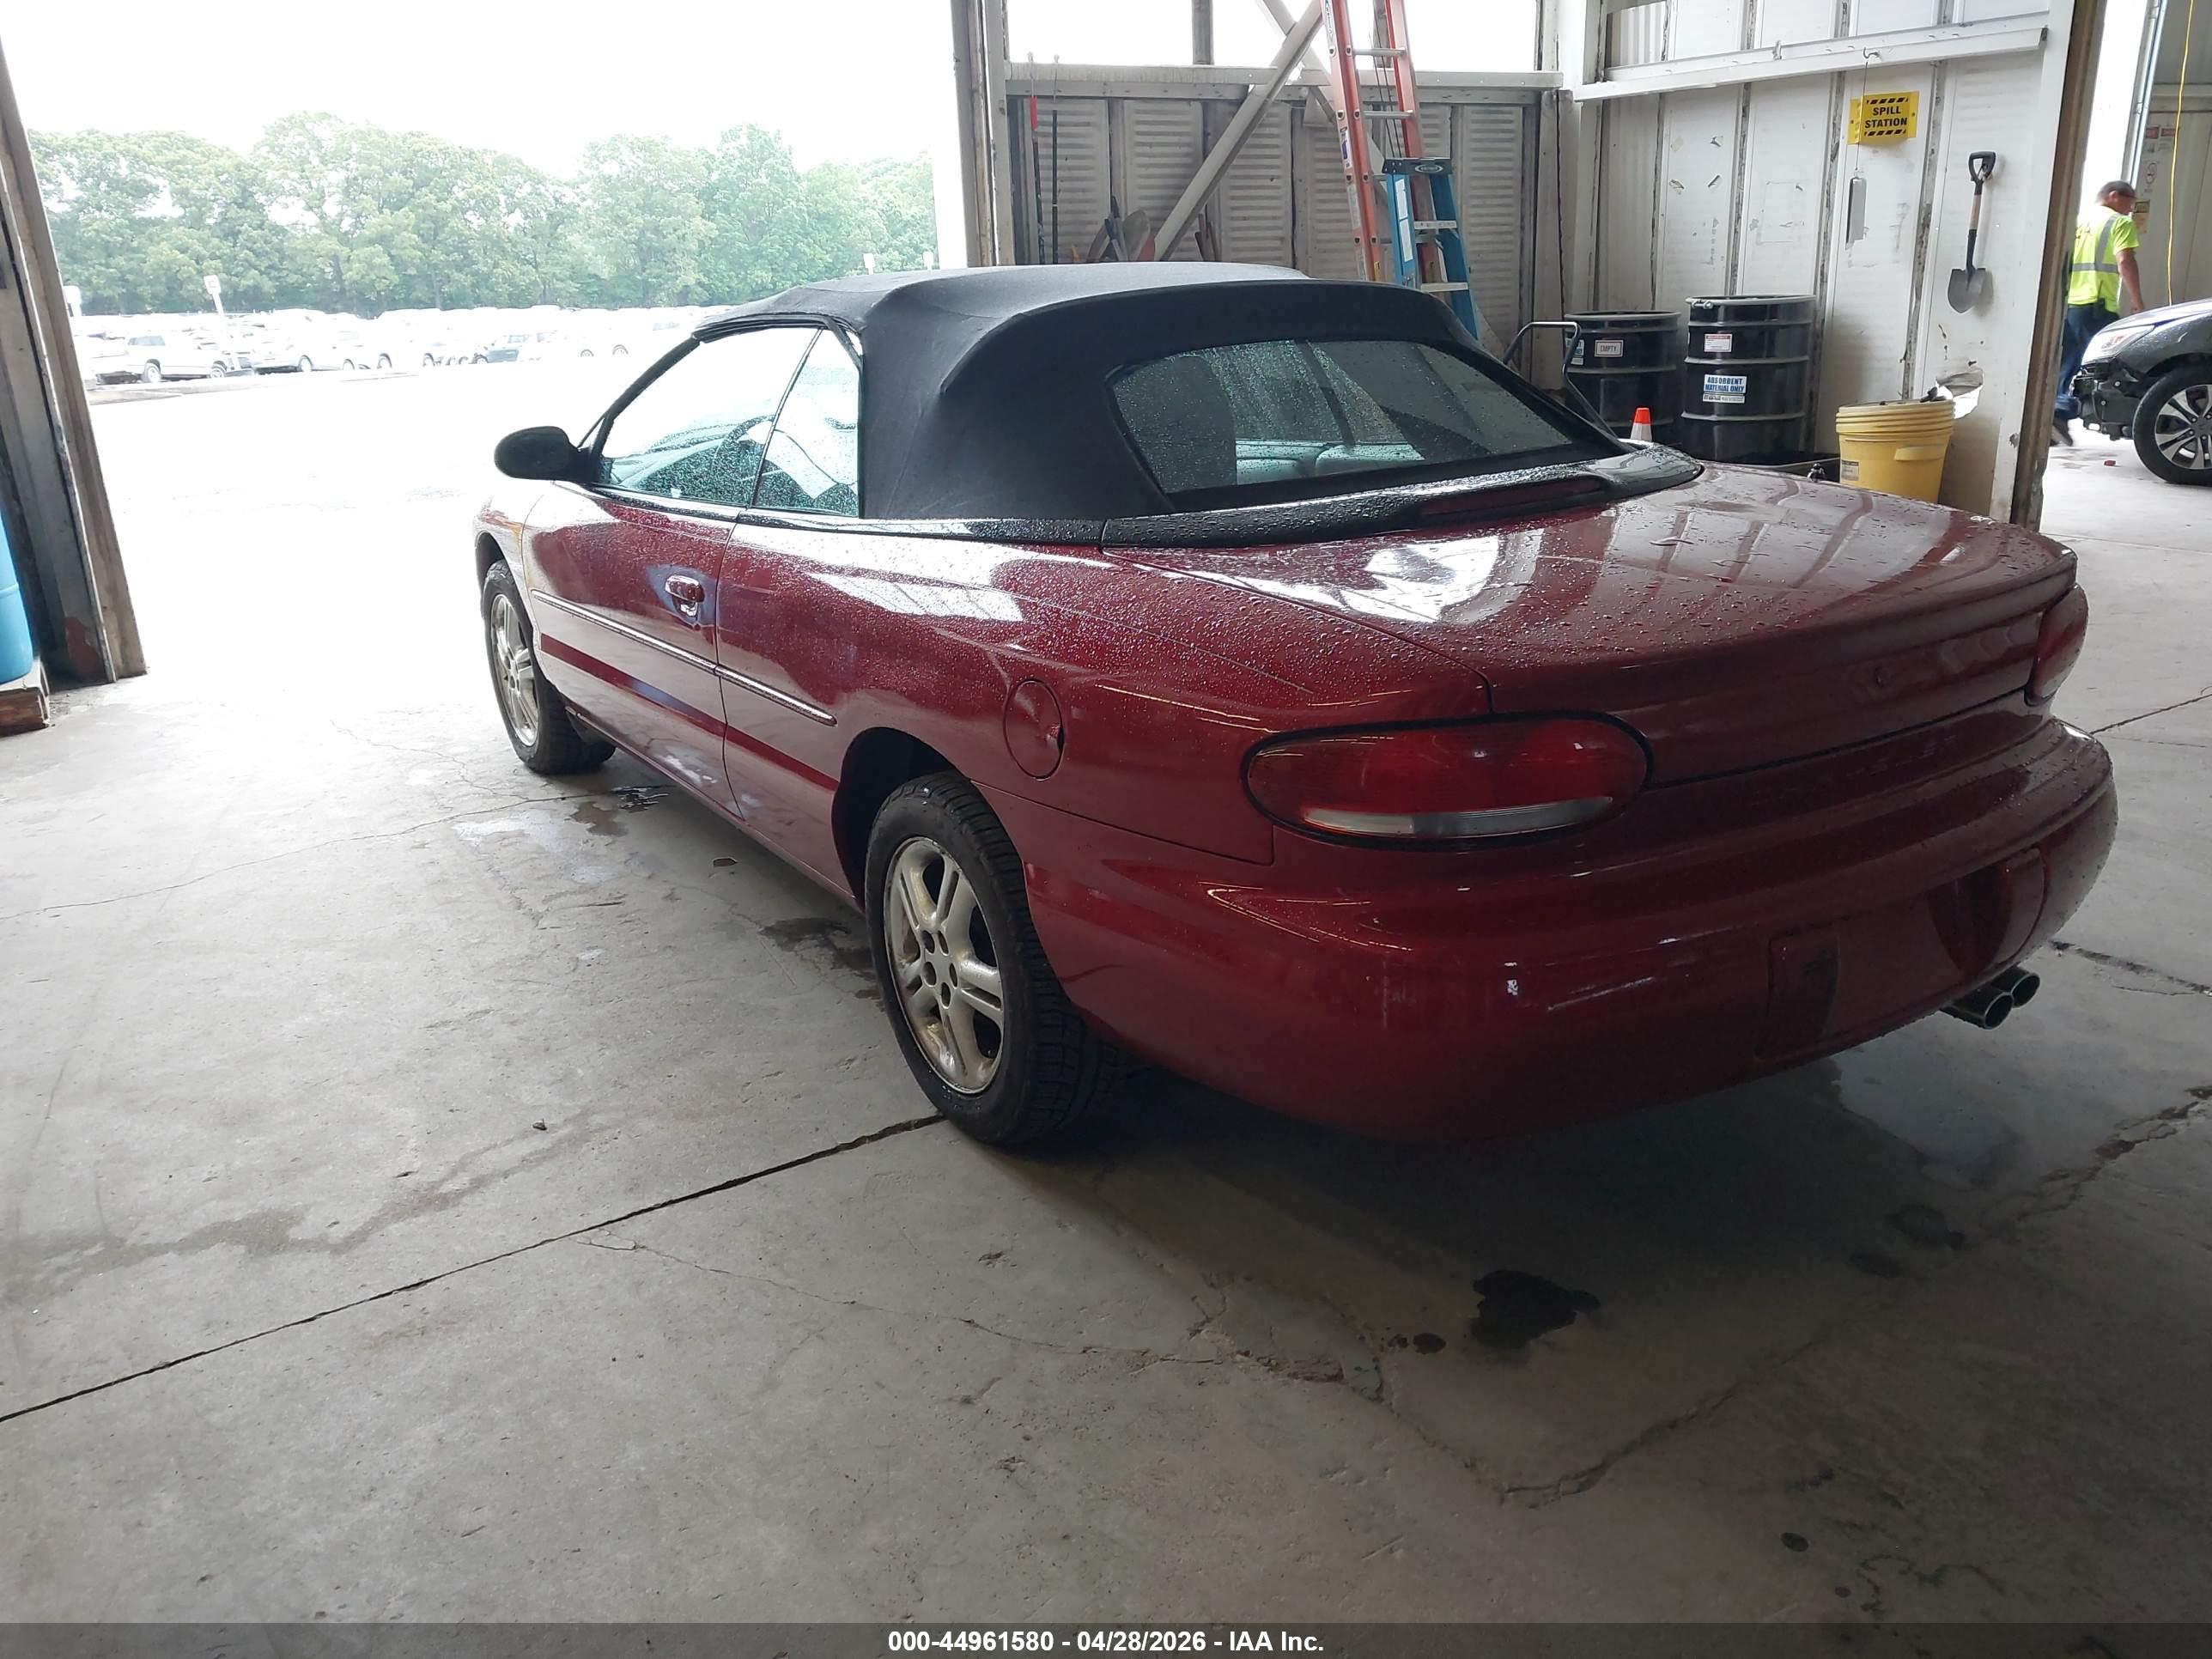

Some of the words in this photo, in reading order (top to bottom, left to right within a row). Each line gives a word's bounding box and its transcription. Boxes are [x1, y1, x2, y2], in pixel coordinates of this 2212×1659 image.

[1873, 106, 1901, 116] SPILL
[1864, 118, 1907, 129] STATION
[1707, 376, 1743, 386] ABSORBENT
[1705, 383, 1729, 392] MATERIAL
[1730, 385, 1745, 393] ONLY
